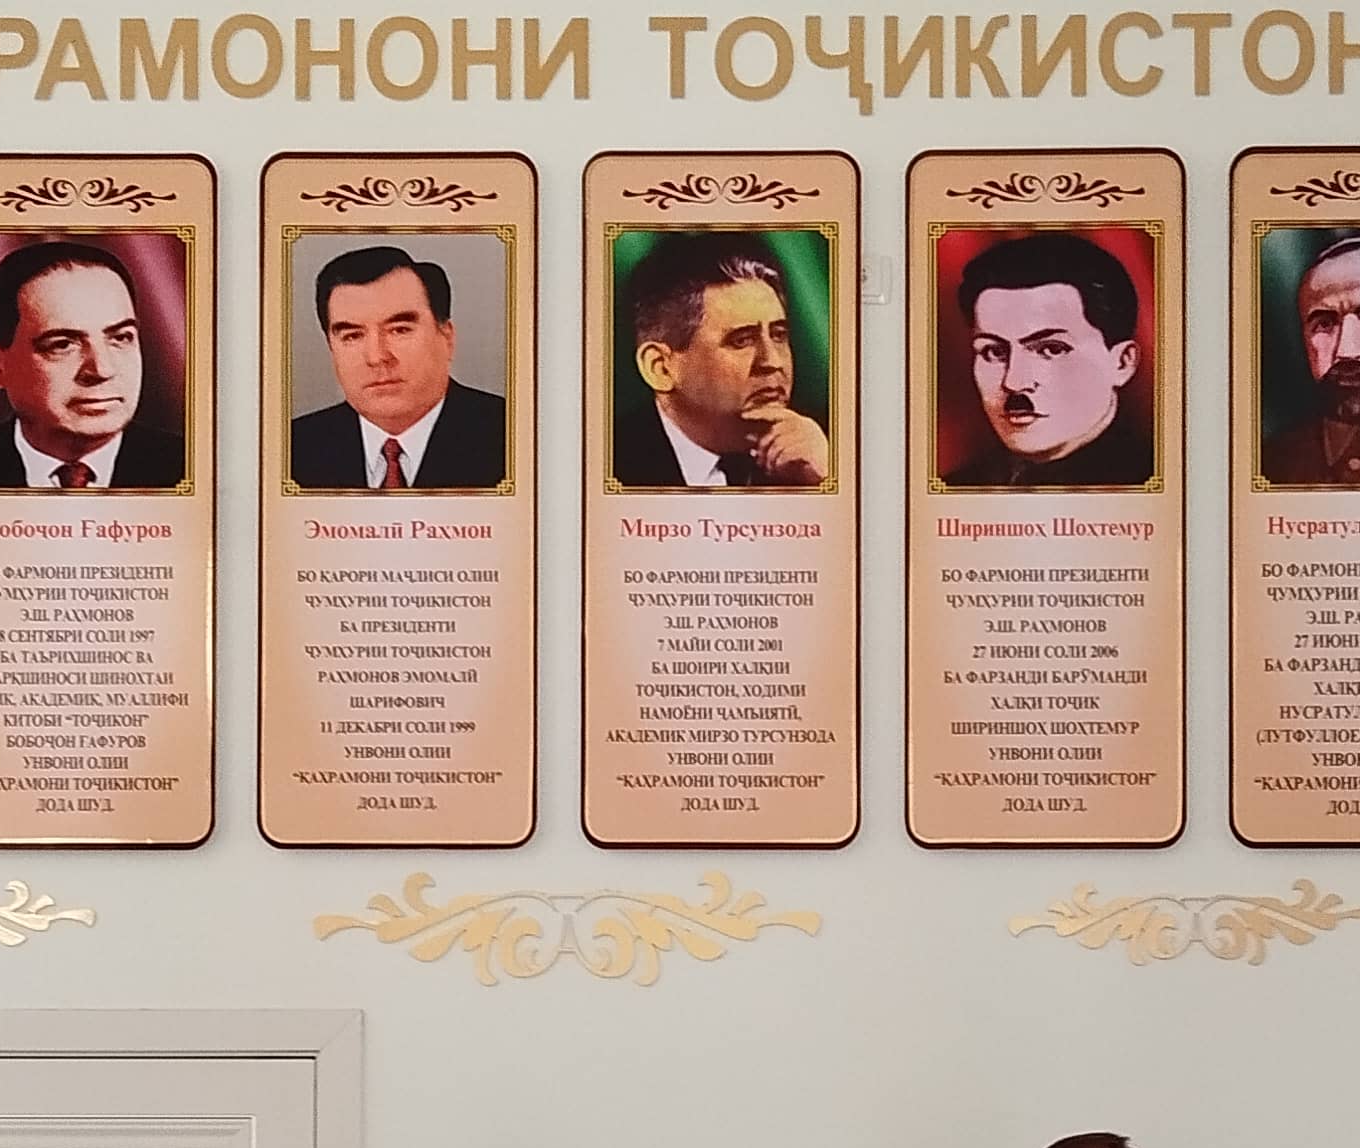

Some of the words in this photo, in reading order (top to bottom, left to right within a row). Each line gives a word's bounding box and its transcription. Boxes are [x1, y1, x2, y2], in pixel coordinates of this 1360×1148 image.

[620, 518, 692, 542] Мирзо
[698, 518, 822, 542] Турсунзода
[3, 566, 77, 580] ФАРМОНИ
[80, 566, 174, 581] ПРЕЗИДЕНТИ
[297, 570, 317, 583] БО
[457, 570, 499, 583] ОЛИИ
[623, 570, 643, 584] БО
[646, 570, 720, 584] ФАРМОНИ
[723, 570, 818, 585] ПРЕЗИДЕНТИ
[941, 569, 962, 583] БО
[965, 569, 1045, 583] ФАРМОНИ
[1048, 568, 1149, 583] ПРЕЗИДЕНТИ
[1262, 564, 1283, 577] БО
[340, 620, 358, 633] БА
[361, 620, 456, 634] ПРЕЗИДЕНТИ
[8, 630, 83, 643] СЕНТЯБРИ
[86, 630, 126, 643] СОЛИ
[129, 630, 155, 643] 1997
[1294, 635, 1309, 648] 27
[657, 639, 665, 652] 7
[667, 637, 711, 652] МАЙИ
[714, 639, 755, 652] СОЛИ
[758, 639, 783, 652] 2001
[0, 650, 18, 664] БА
[22, 650, 133, 664] ТАЪРИХШИНОС
[973, 646, 986, 658] 27
[990, 645, 1041, 659] ИЮНИ
[1044, 645, 1087, 659] СОЛИ
[1090, 645, 1119, 658] 2006
[651, 661, 669, 675] БА
[672, 661, 728, 675] ШОИРИ
[1264, 658, 1284, 672] БА
[943, 671, 962, 684] БА
[966, 671, 1048, 685] ФАРЗАНДИ
[742, 684, 806, 698] ХОДИМИ
[350, 696, 445, 709] ШАРИФОВИЧ
[639, 705, 713, 720] НАМОЁНИ
[3, 714, 62, 727] КИТОБИ
[320, 722, 333, 734] 11
[335, 721, 402, 735] ДЕКАБРИ
[405, 721, 446, 734] СОЛИ
[449, 722, 476, 734] 1999
[605, 729, 687, 744] АКАДЕМИК
[689, 729, 739, 743] МИРЗО
[742, 729, 836, 744] ТУРСУНЗОДА
[344, 746, 406, 759] УНВОНИ
[408, 746, 451, 759] ОЛИИ
[667, 753, 729, 765] УНВОНИ
[732, 753, 774, 765] ОЛИИ
[988, 747, 1054, 761] УНВОНИ
[1057, 747, 1103, 761] ОЛИИ
[23, 756, 84, 770] УНВОНИ
[87, 756, 129, 770] ОЛИИ
[357, 797, 397, 810] ДОДА
[681, 798, 720, 811] ДОДА
[1002, 798, 1044, 812] ДОДА
